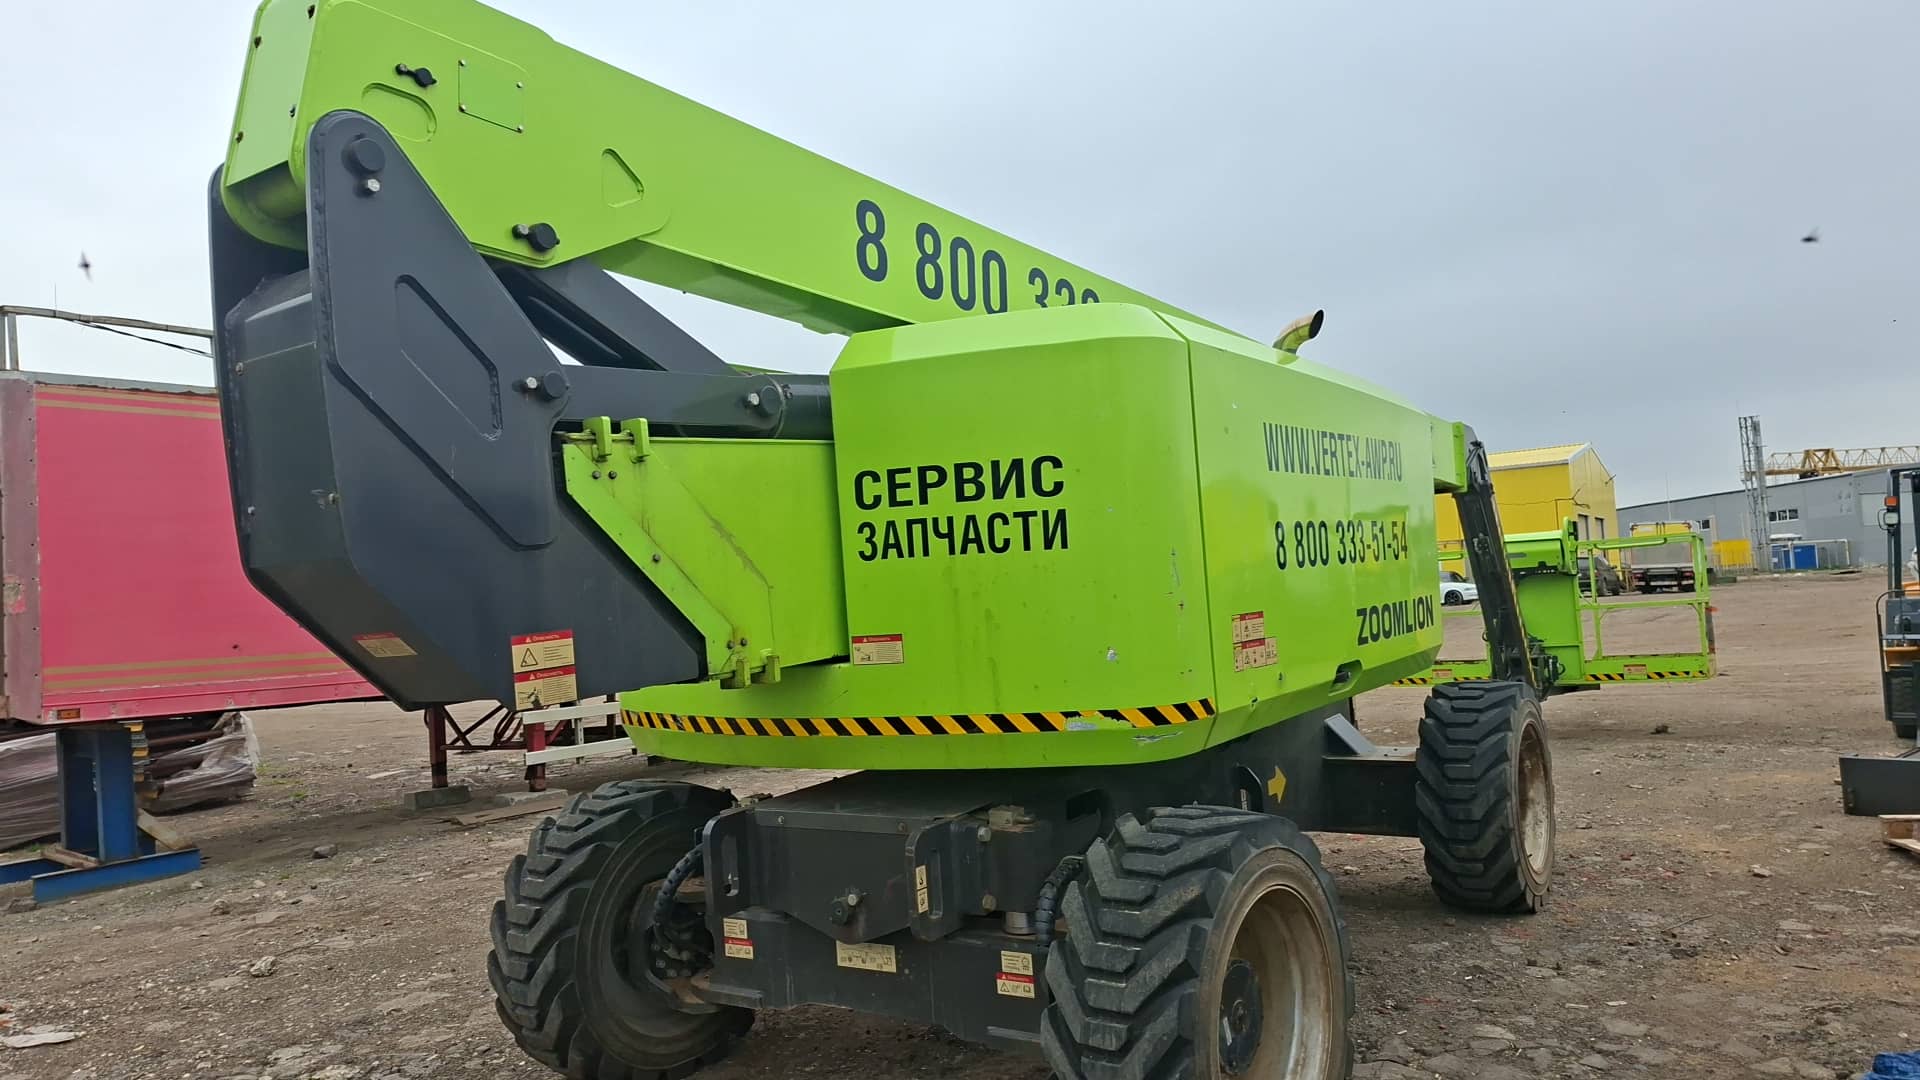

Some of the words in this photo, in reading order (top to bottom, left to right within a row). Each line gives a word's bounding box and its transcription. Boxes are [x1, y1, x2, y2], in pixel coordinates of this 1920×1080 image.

[856, 199, 887, 282] 8
[916, 222, 1008, 314] 800
[1263, 421, 1402, 482] WWW.VERTEX-AWP.RU
[854, 455, 1064, 510] СЕРВИС
[857, 508, 1068, 561] ЗАПЧАСТИ
[1275, 521, 1287, 570] 8
[1294, 520, 1329, 568] 800
[1336, 520, 1407, 565] 333-51-54
[1356, 595, 1434, 646] ZOOMLION
